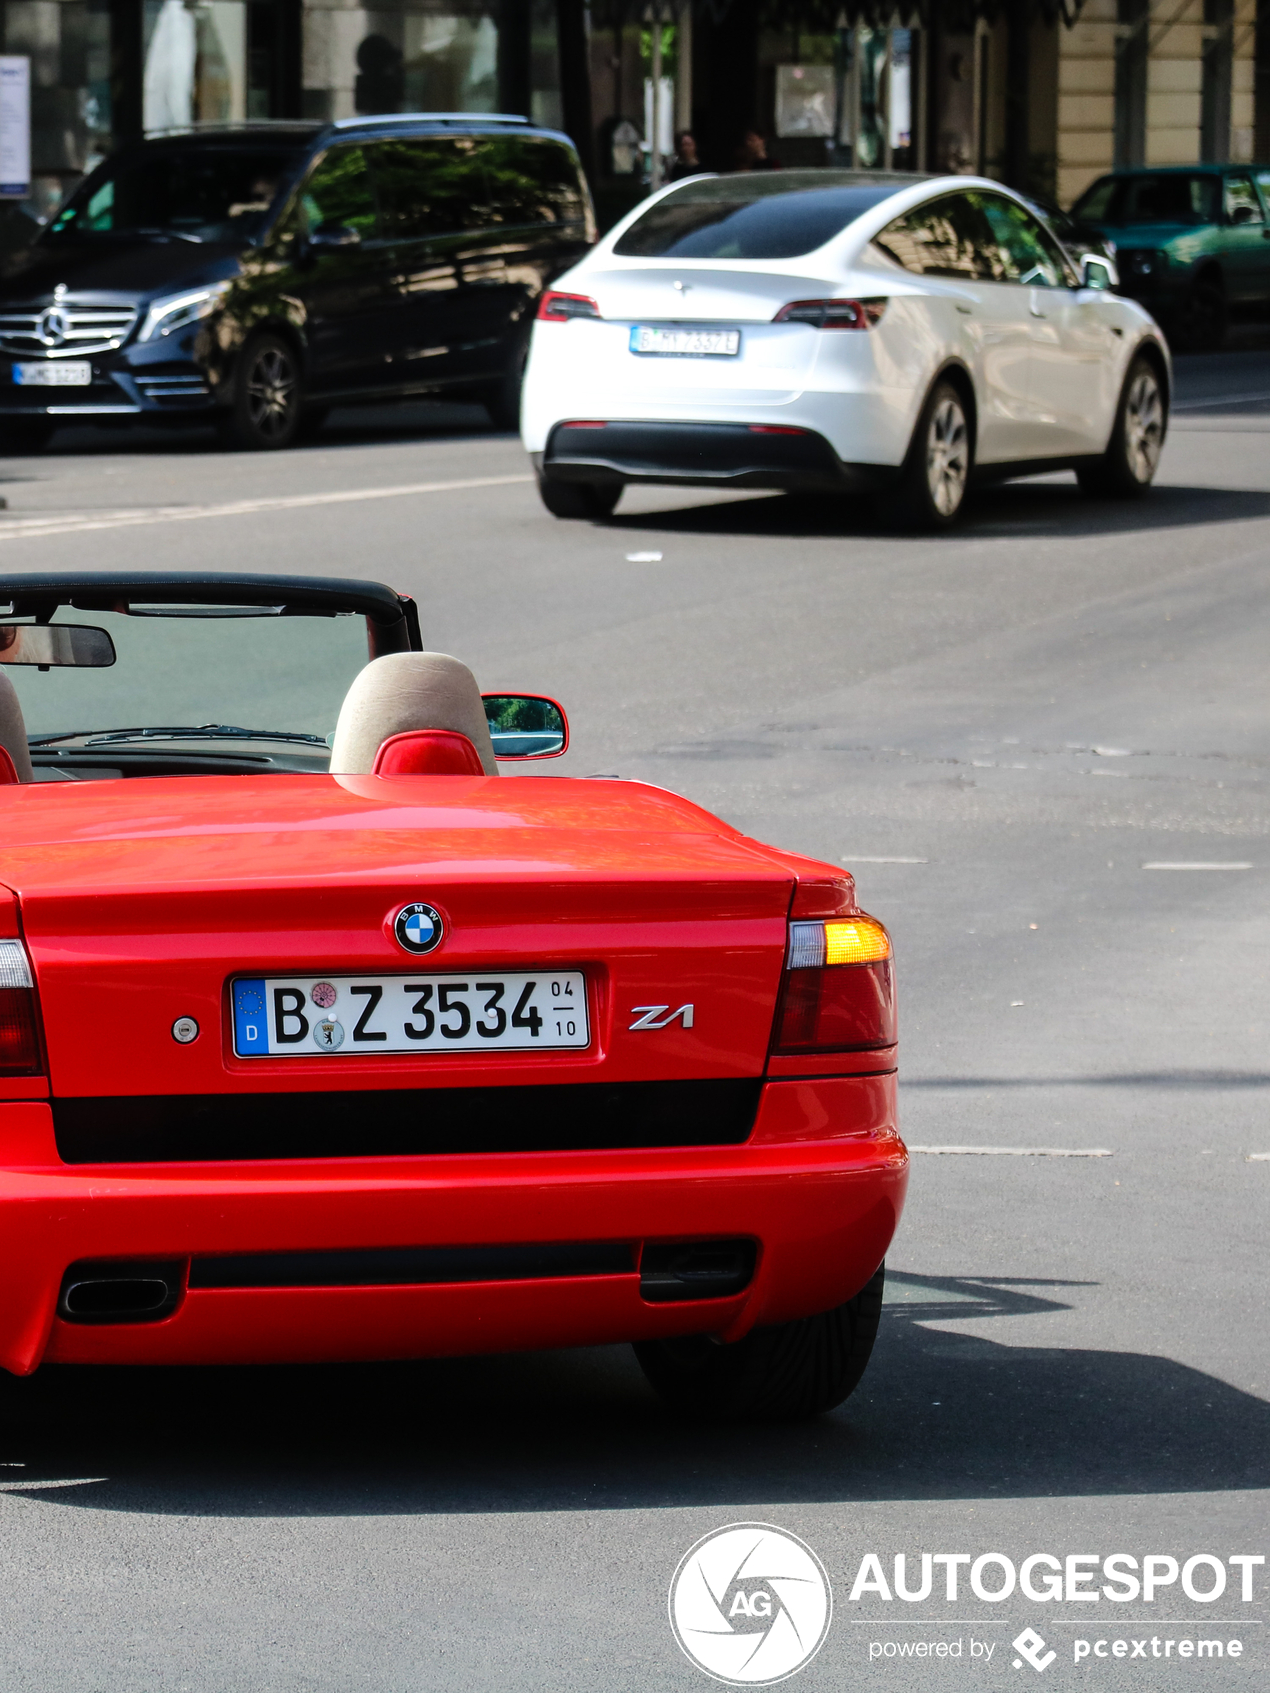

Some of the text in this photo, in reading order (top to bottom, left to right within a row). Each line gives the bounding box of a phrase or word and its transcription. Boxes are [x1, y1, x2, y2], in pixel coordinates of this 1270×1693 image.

[400, 905, 438, 921] BMW
[551, 981, 573, 996] 04
[274, 982, 542, 1043] B Z 3534
[629, 1004, 694, 1029] Z1
[246, 1025, 258, 1041] D
[556, 1021, 575, 1036] 10
